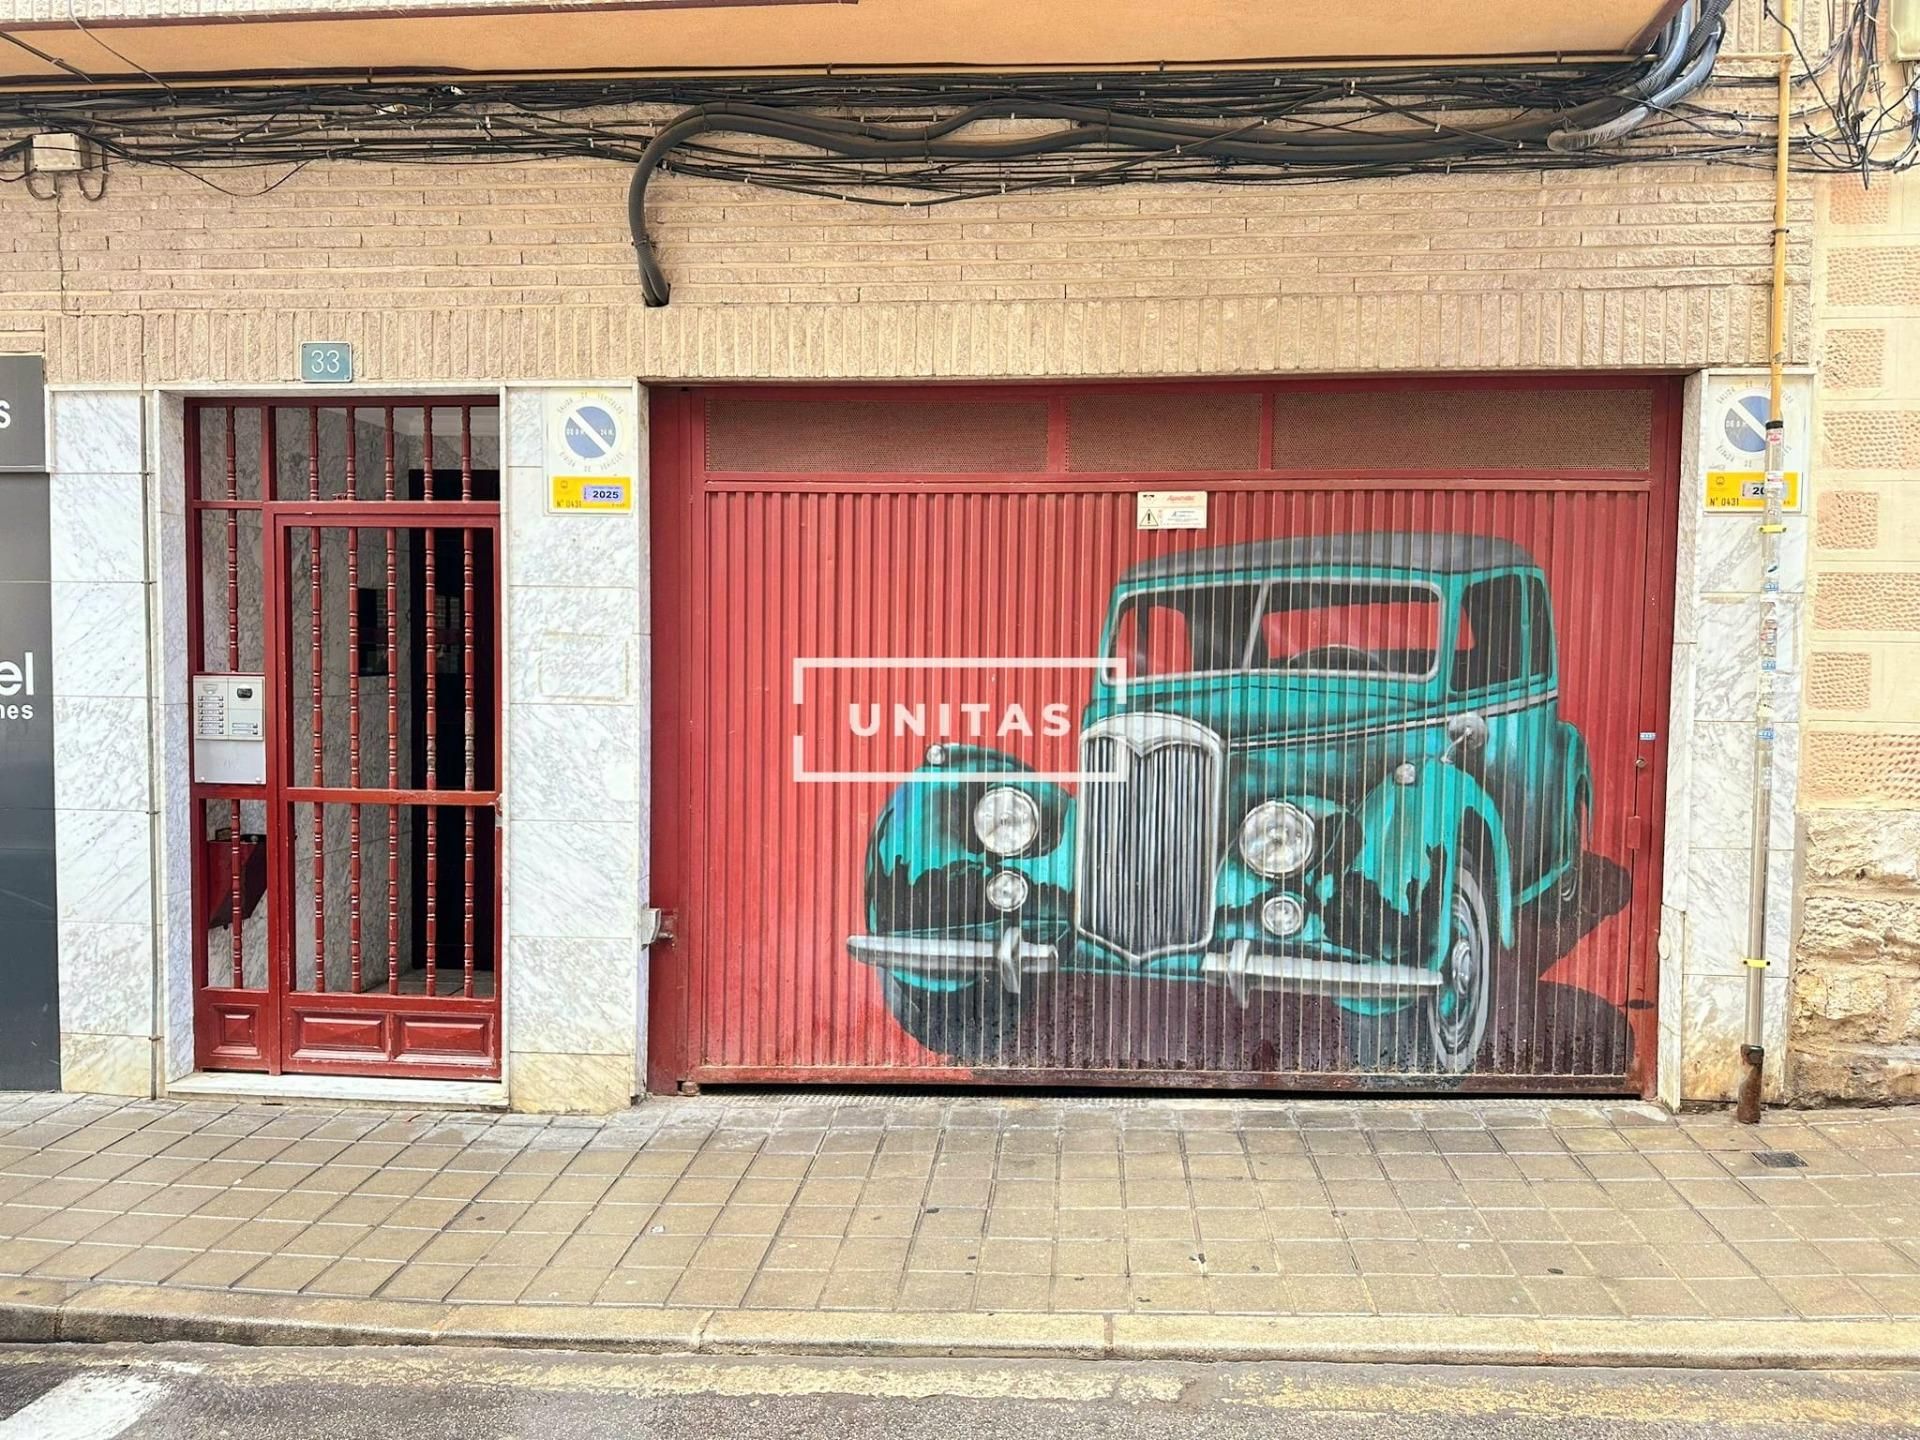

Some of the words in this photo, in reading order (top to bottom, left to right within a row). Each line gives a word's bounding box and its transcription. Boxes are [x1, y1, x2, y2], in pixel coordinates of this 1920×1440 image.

[311, 350, 340, 374] 33
[592, 490, 619, 499] 2025
[1721, 497, 1739, 507] 0431
